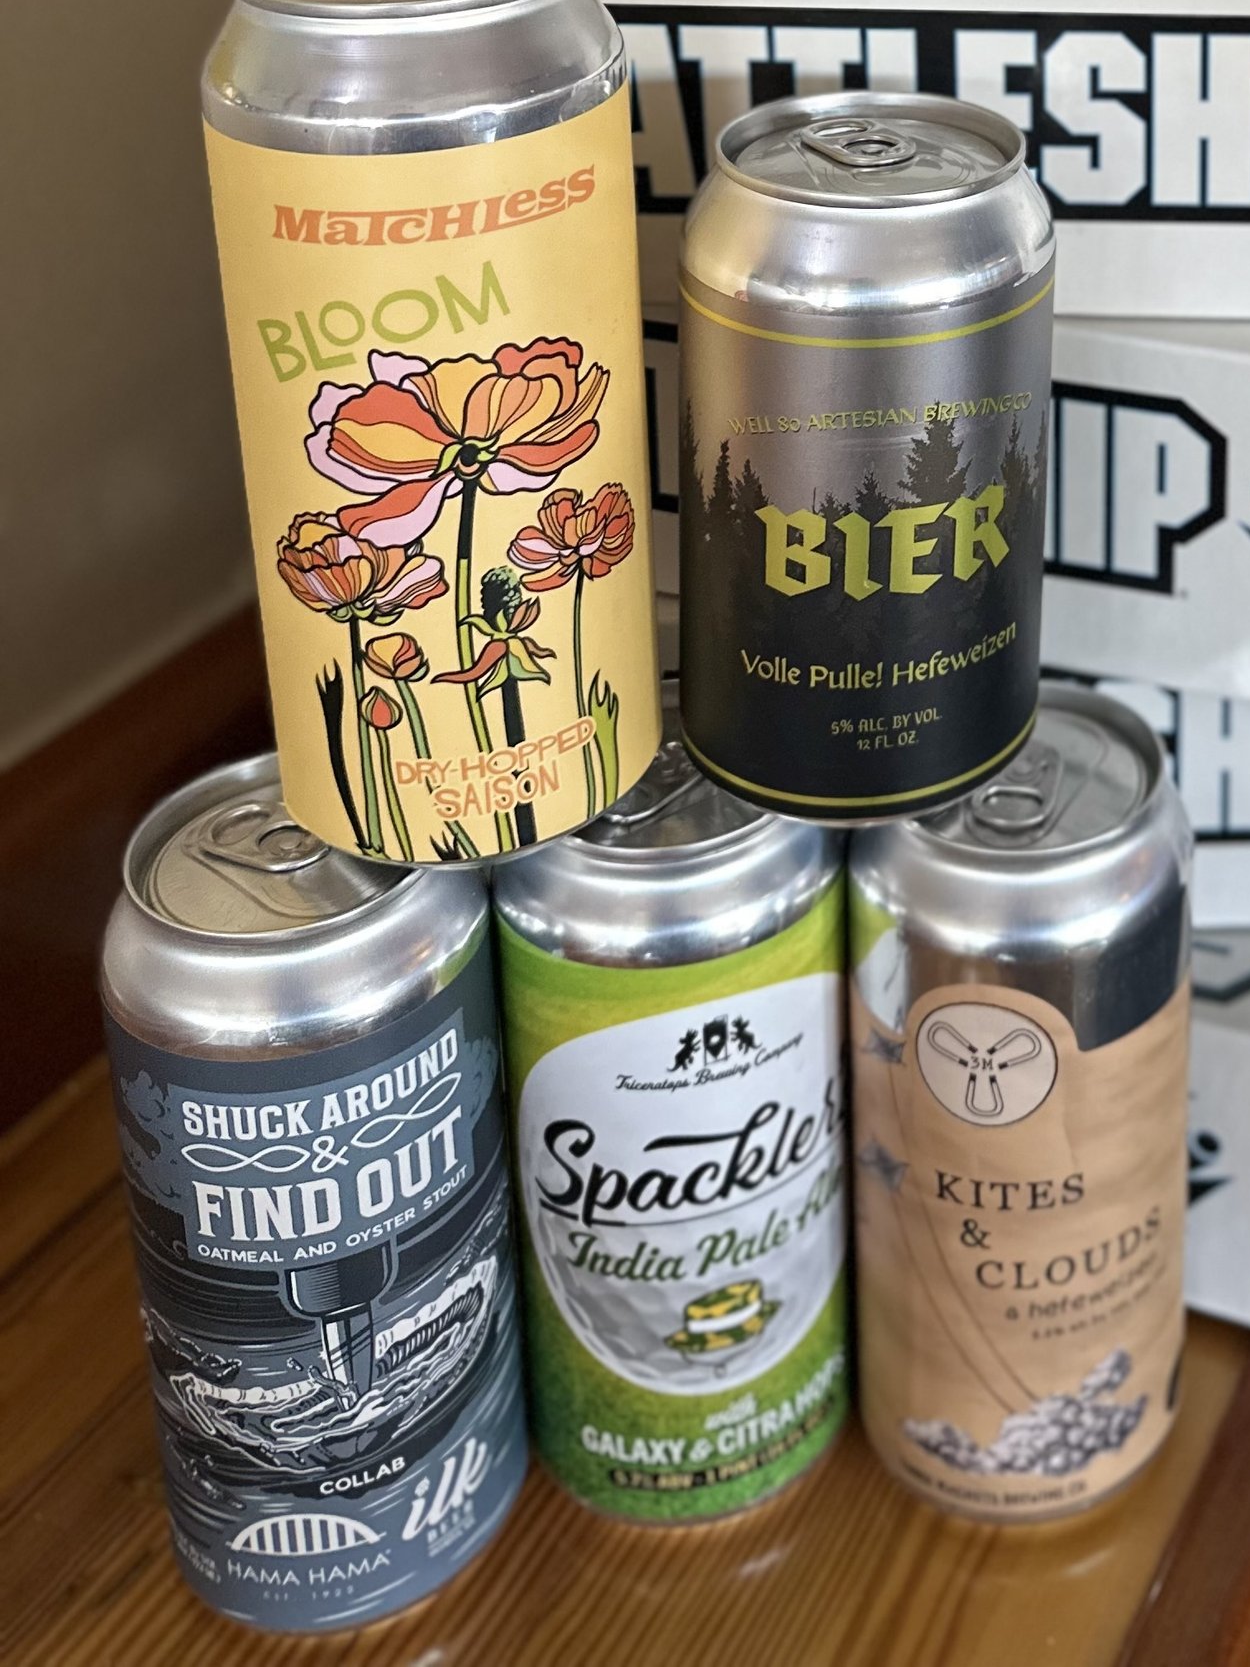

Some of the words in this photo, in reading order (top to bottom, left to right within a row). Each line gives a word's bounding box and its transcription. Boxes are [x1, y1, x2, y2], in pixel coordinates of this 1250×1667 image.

[256, 260, 511, 384] BLOOM
[727, 416, 774, 436] WELL
[777, 415, 801, 433] 80
[807, 406, 916, 432] ARTESIAN
[922, 393, 1011, 424] BREWING
[754, 484, 1010, 602] BIER
[741, 648, 801, 686] Volle
[809, 661, 884, 690] Pulle!
[892, 621, 1017, 687] Hefeweizen
[395, 718, 596, 786] DRY-HOPPED
[831, 719, 854, 735] 5%
[892, 713, 911, 730] BY
[856, 738, 871, 751] 12
[434, 759, 560, 820] SAISON
[181, 1099, 314, 1142] SHUCK
[319, 1027, 459, 1131] AROUND
[693, 1062, 751, 1086] Brewing
[969, 1056, 995, 1071] 3M
[192, 1176, 342, 1242] FIND
[355, 1104, 465, 1219] OUT
[311, 1135, 349, 1174] &
[197, 1243, 285, 1264] OATMEAL
[293, 1241, 337, 1261] AND
[346, 1208, 416, 1246] OYSTER
[423, 1165, 468, 1212] STOUT
[935, 1169, 1086, 1212] KITES
[567, 1230, 687, 1282] India
[696, 1208, 790, 1277] Pale
[959, 1218, 992, 1251] &
[975, 1205, 1162, 1291] CLOUDS
[580, 1423, 687, 1466] GALAXY
[716, 1400, 796, 1453] CITRA
[319, 1455, 406, 1496] COLLAB
[227, 1558, 301, 1587] HAMA
[308, 1553, 391, 1584] HAMA
